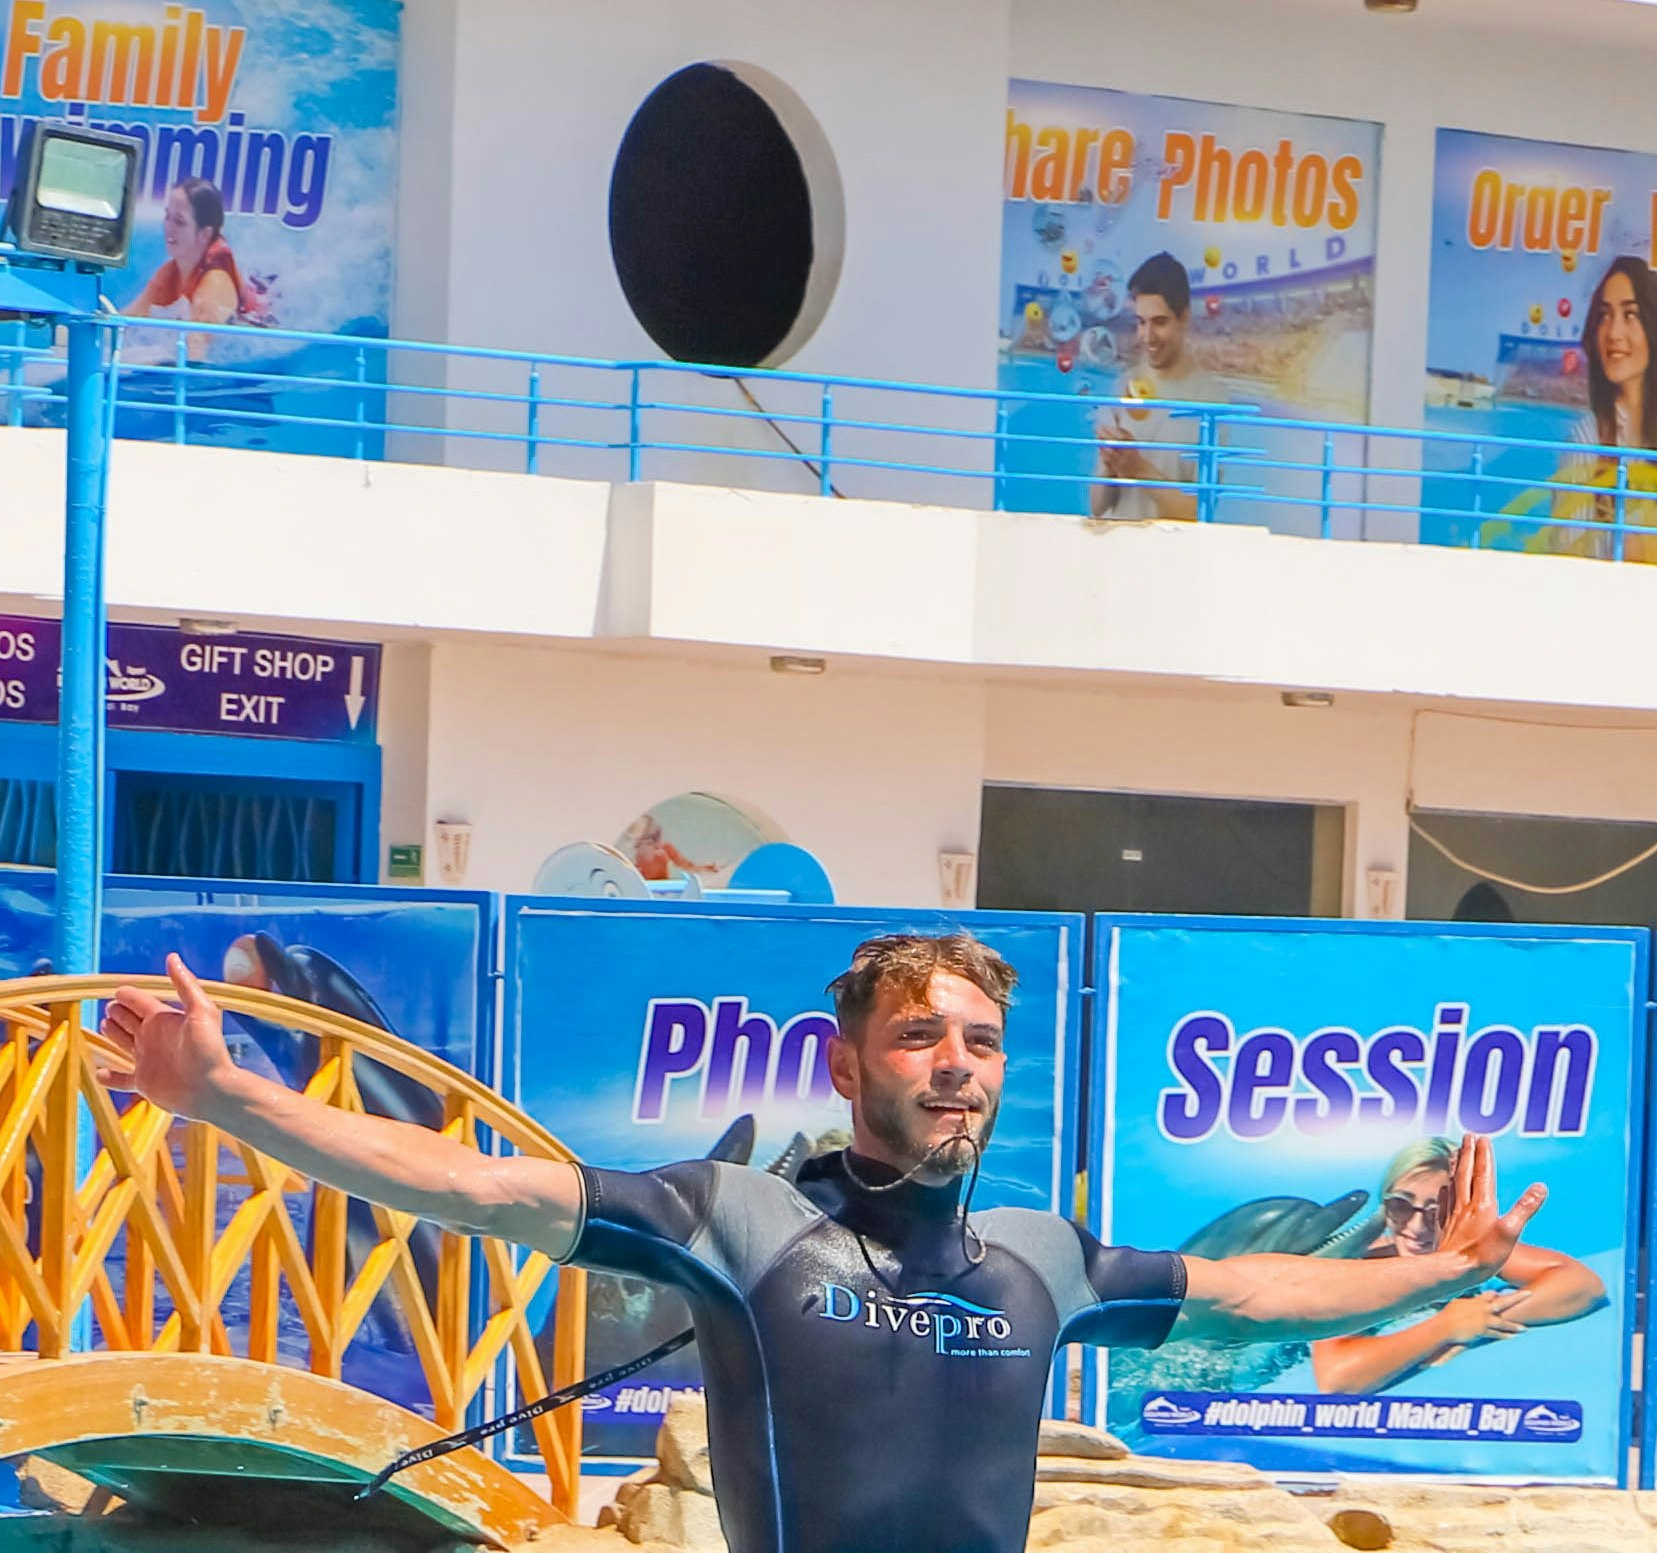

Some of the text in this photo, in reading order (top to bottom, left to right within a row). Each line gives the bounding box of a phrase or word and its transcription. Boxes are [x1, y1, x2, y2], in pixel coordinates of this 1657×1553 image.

[2, 0, 246, 123] Family
[1004, 107, 1363, 230] hare Photos
[180, 644, 335, 681] GIFT SHOP
[220, 693, 285, 724] EXIT
[637, 1000, 839, 1121] Pho
[1162, 1008, 1593, 1140] Session
[979, 1348, 999, 1356] than
